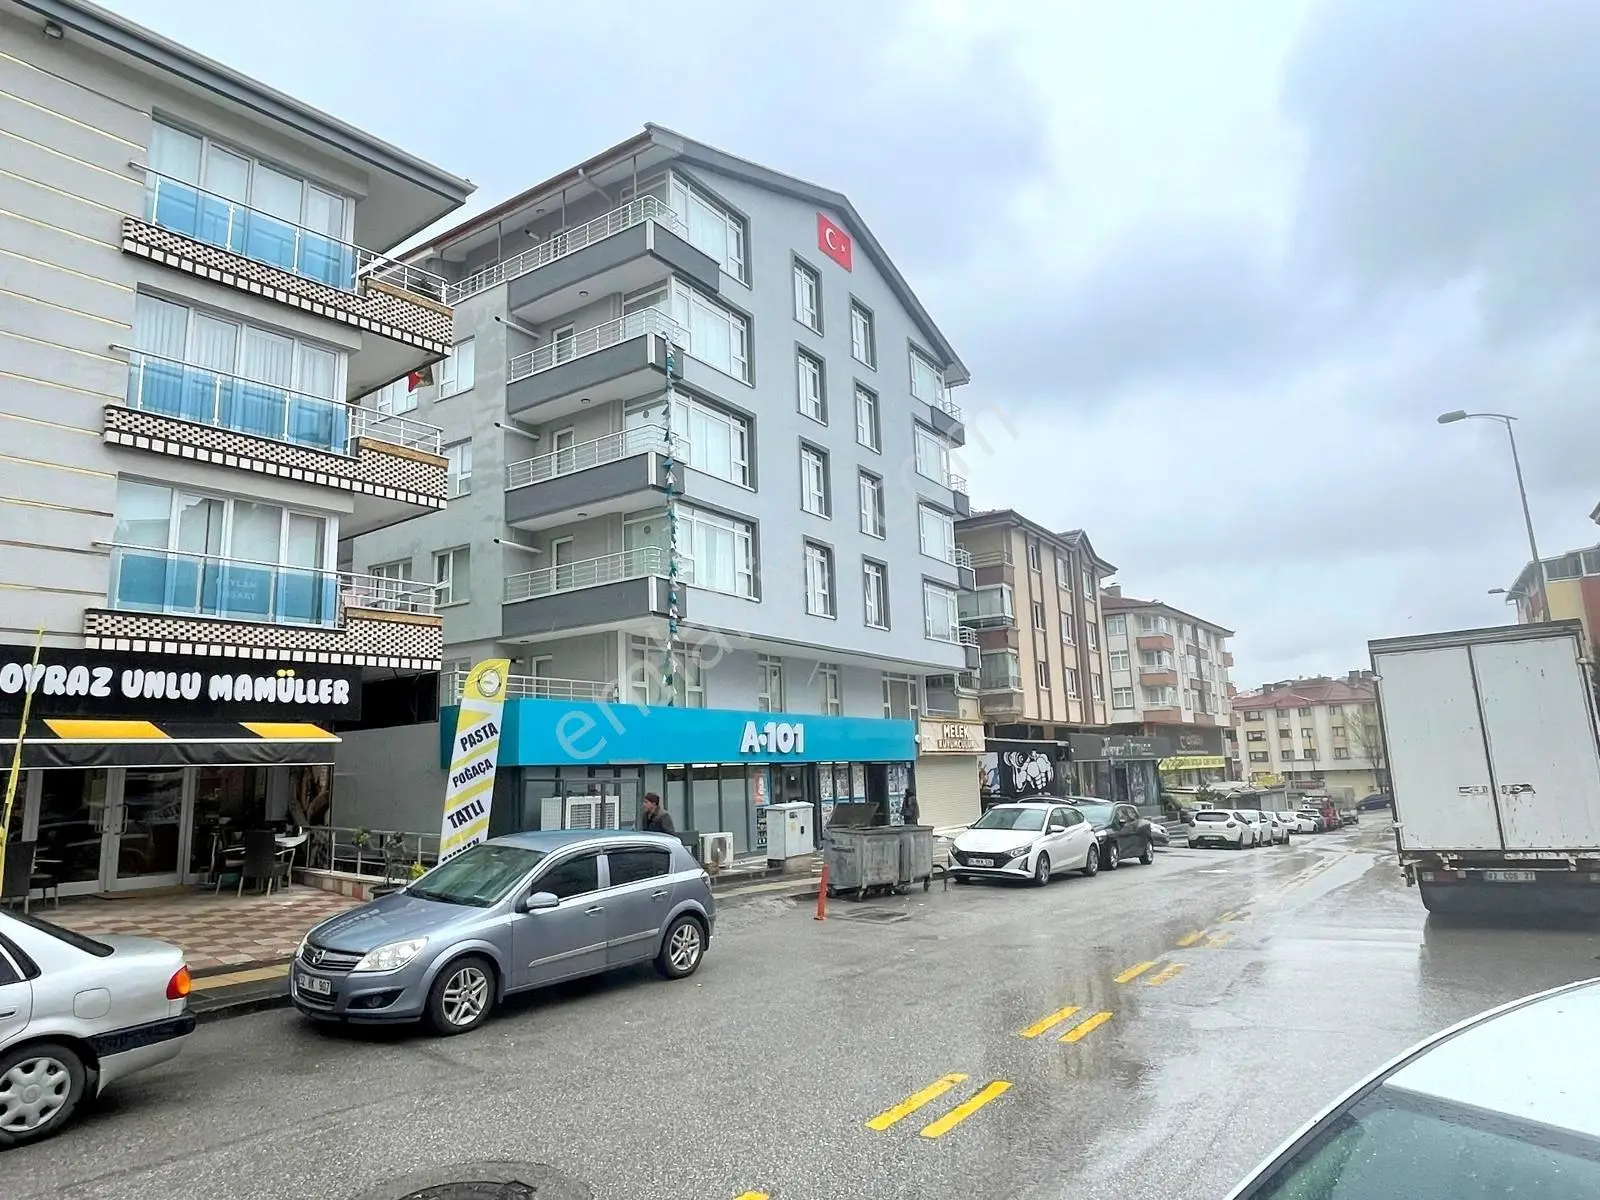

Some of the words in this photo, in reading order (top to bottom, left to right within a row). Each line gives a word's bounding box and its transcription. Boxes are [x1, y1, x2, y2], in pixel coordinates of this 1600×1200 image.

[121, 668, 202, 700] UNLU
[208, 669, 350, 705] MAMÜLLER
[460, 722, 499, 752] PASTA
[942, 723, 969, 740] MELEK
[452, 758, 493, 788] POĞAÇA
[447, 799, 485, 829] TATLI
